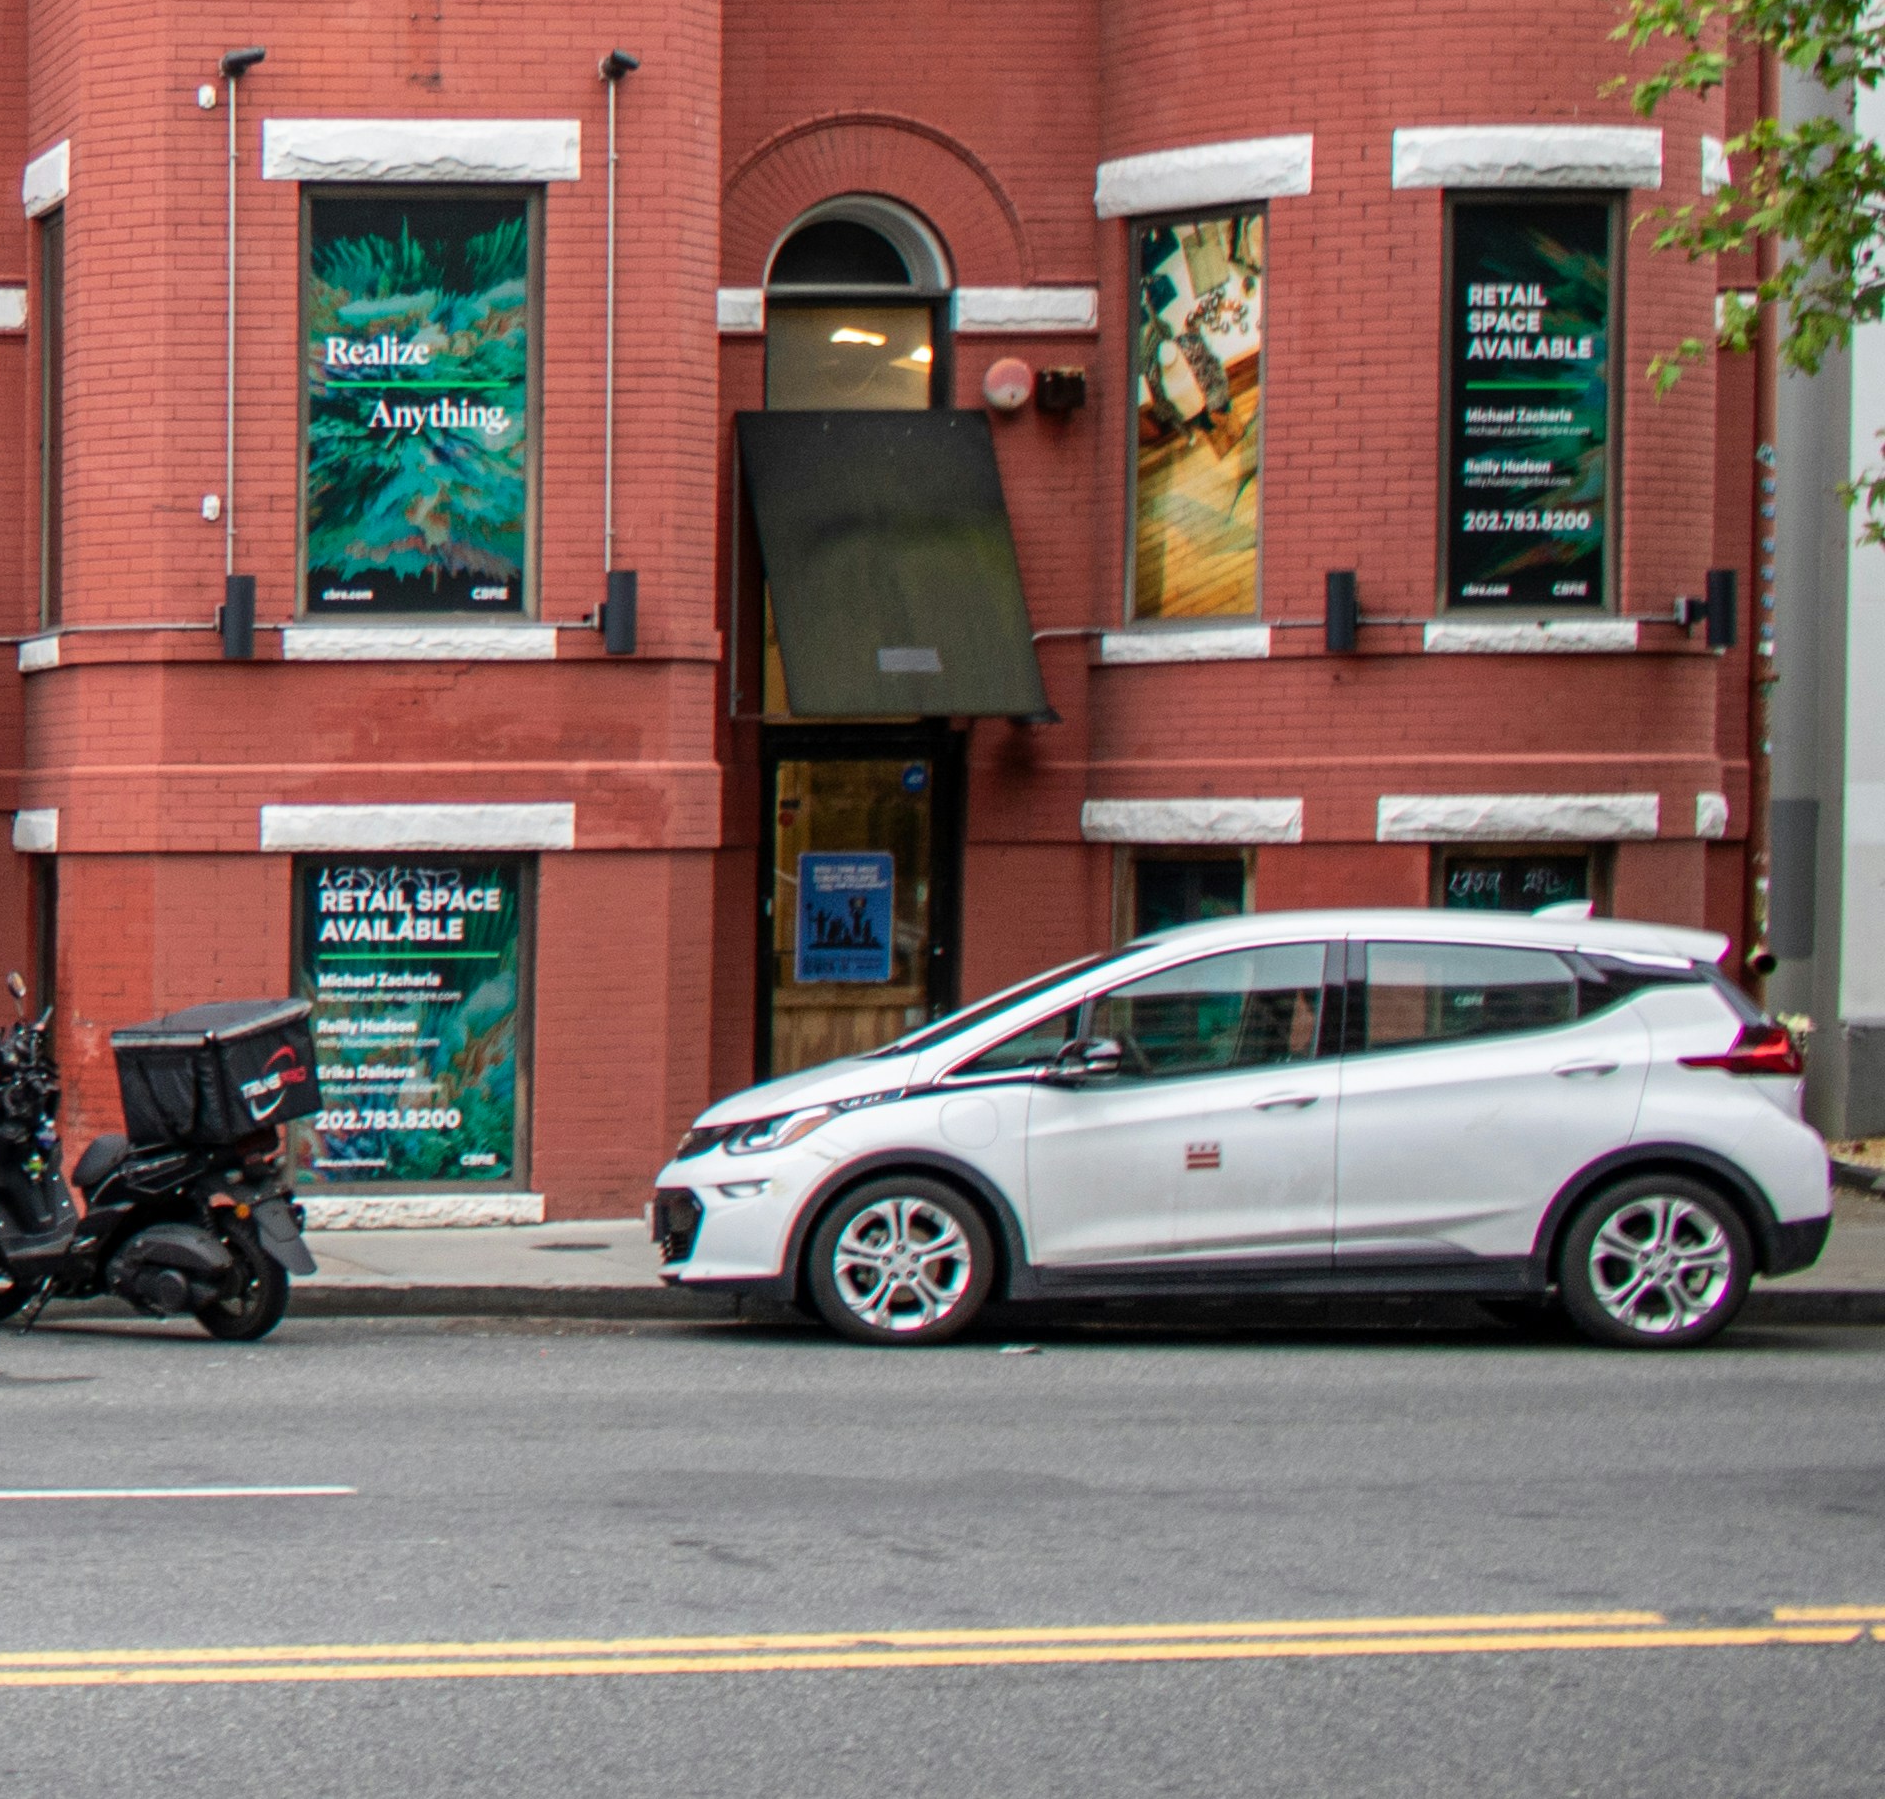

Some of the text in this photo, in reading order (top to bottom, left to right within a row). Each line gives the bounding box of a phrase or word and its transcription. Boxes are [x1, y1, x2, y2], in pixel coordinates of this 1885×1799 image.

[1468, 283, 1548, 307] RETAIL
[1467, 310, 1541, 333] SPACE
[324, 335, 429, 365] Realize
[1467, 336, 1593, 360] AVAILABLE
[368, 398, 511, 435] Anything.
[1463, 509, 1591, 532] 202.783.8200
[320, 888, 501, 913] RETAIL SPACE
[319, 917, 464, 942] AVAILABLE
[315, 1108, 462, 1130] 202.783.8200
